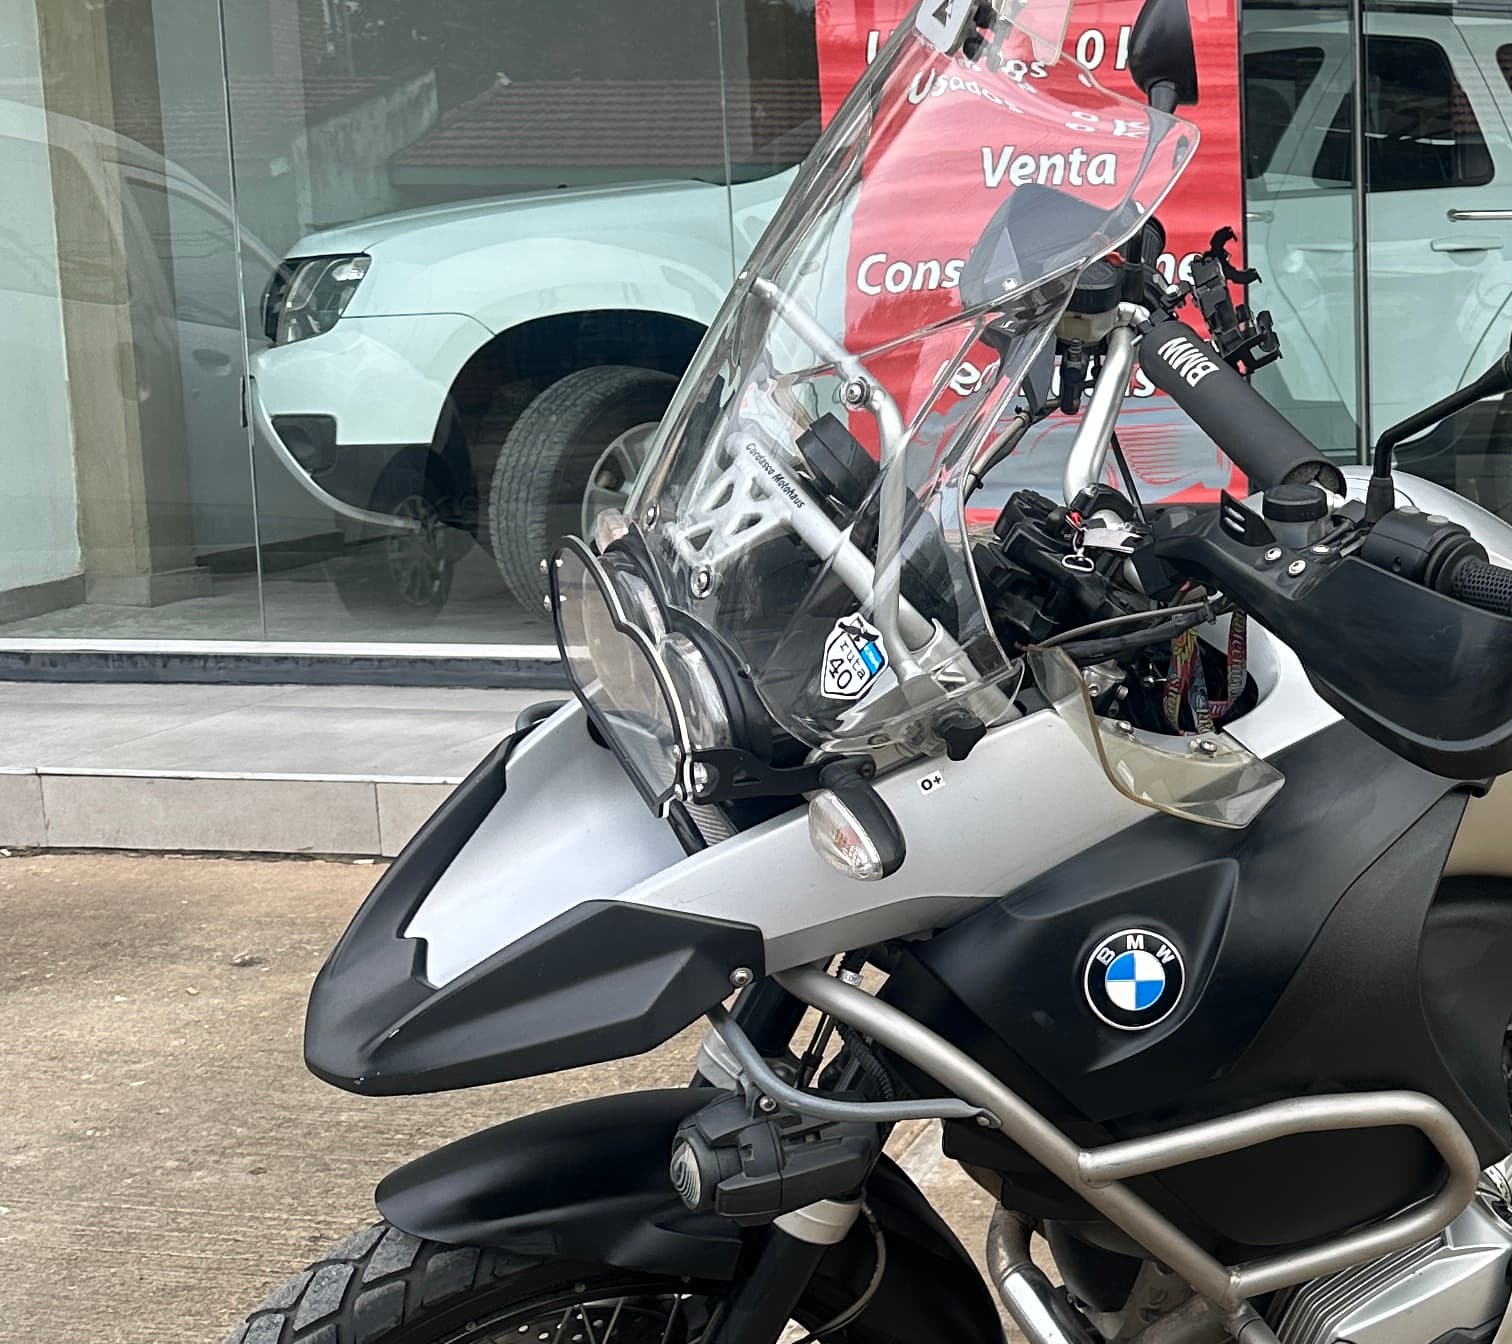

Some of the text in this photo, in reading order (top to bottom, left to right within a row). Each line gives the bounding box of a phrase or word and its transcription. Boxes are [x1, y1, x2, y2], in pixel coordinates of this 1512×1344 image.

[981, 144, 1118, 188] Venta
[1157, 336, 1220, 388] BMW
[828, 657, 853, 689] 40
[840, 640, 866, 681] ruta
[1096, 934, 1175, 966] BMW
